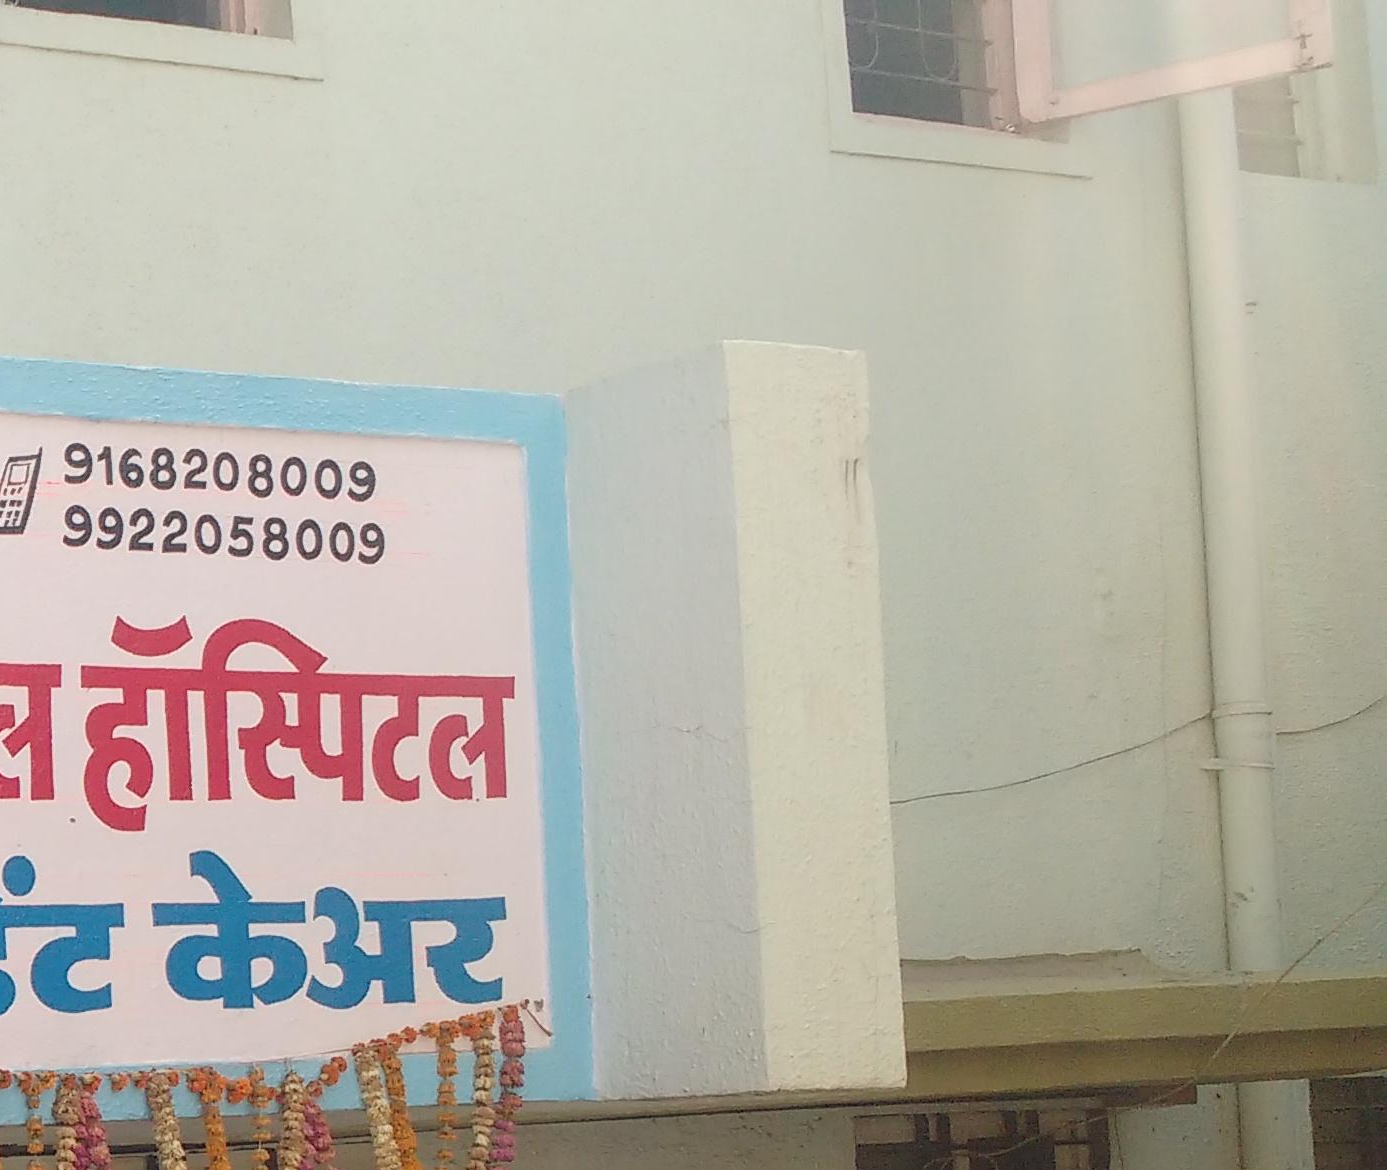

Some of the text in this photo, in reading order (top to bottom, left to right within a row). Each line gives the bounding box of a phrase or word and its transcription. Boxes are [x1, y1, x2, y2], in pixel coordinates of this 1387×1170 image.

[63, 442, 377, 502] 9168208009
[62, 505, 385, 565] 9922058009
[81, 616, 515, 831] हॉस्पिटल
[153, 851, 505, 1009] केअर
